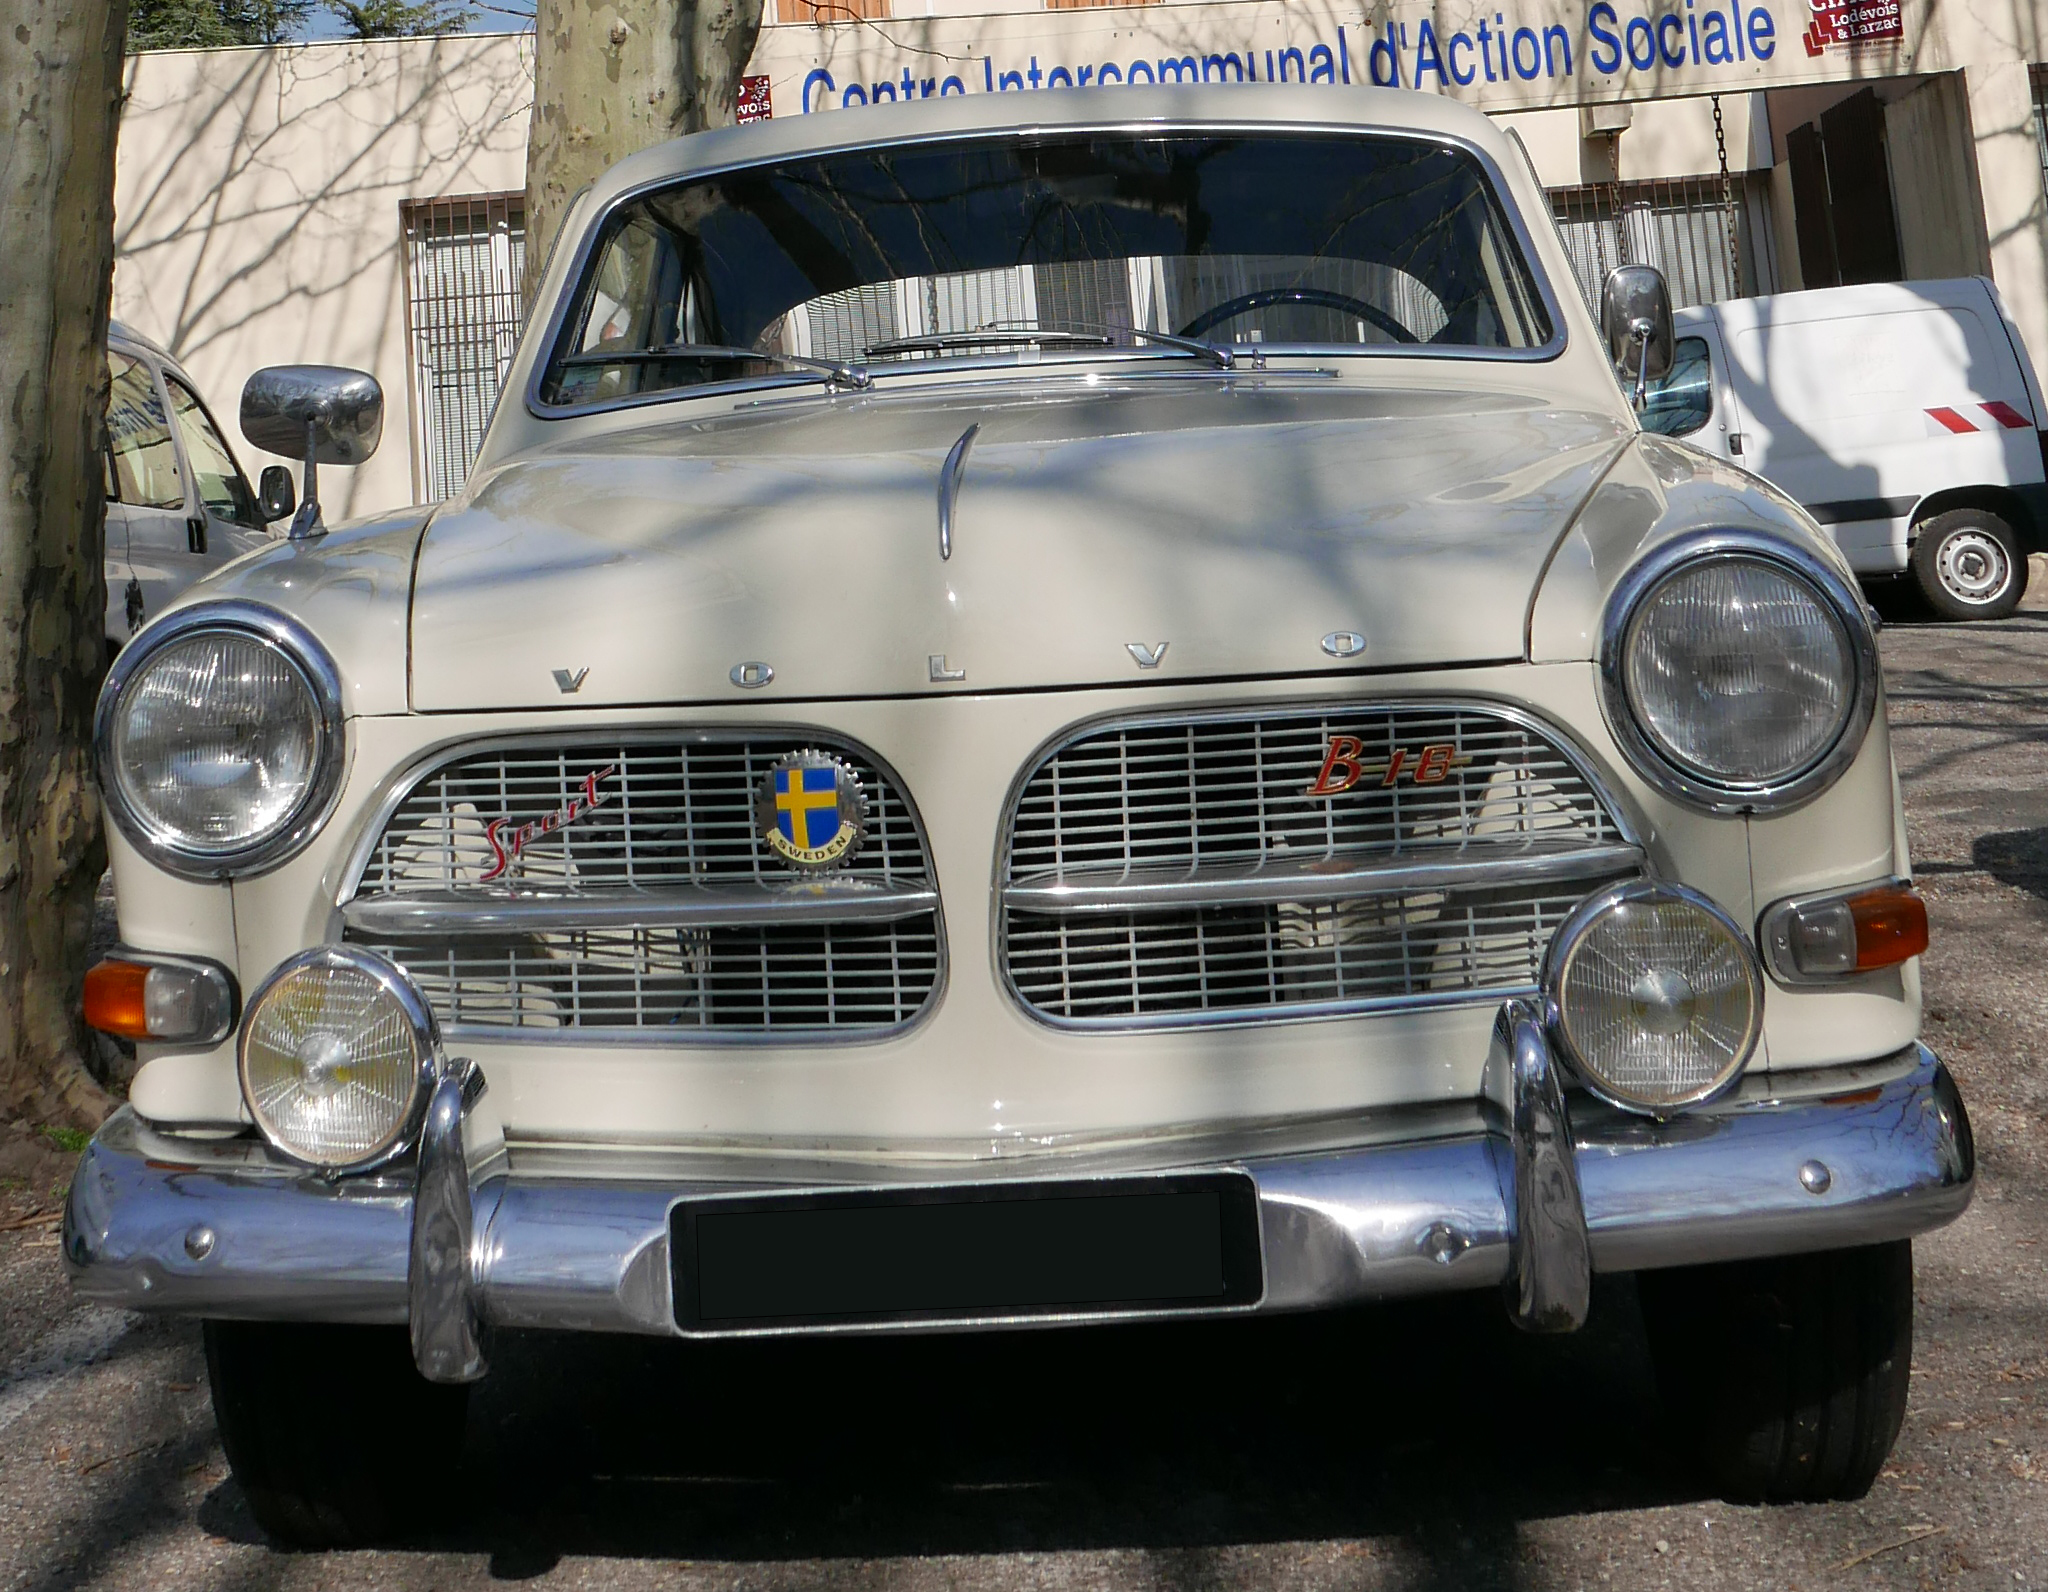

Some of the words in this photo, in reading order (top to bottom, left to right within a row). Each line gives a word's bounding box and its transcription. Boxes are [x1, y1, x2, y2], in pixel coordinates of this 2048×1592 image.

[1829, 3, 1899, 27] Lodévois
[1838, 28, 1848, 39] &
[1848, 17, 1900, 37] Larzac
[1370, 13, 1573, 90] d'Action
[1589, 0, 1776, 75] Sociale
[737, 101, 770, 115] vois
[480, 764, 615, 882] Sport
[778, 836, 846, 860] SWEDEN
